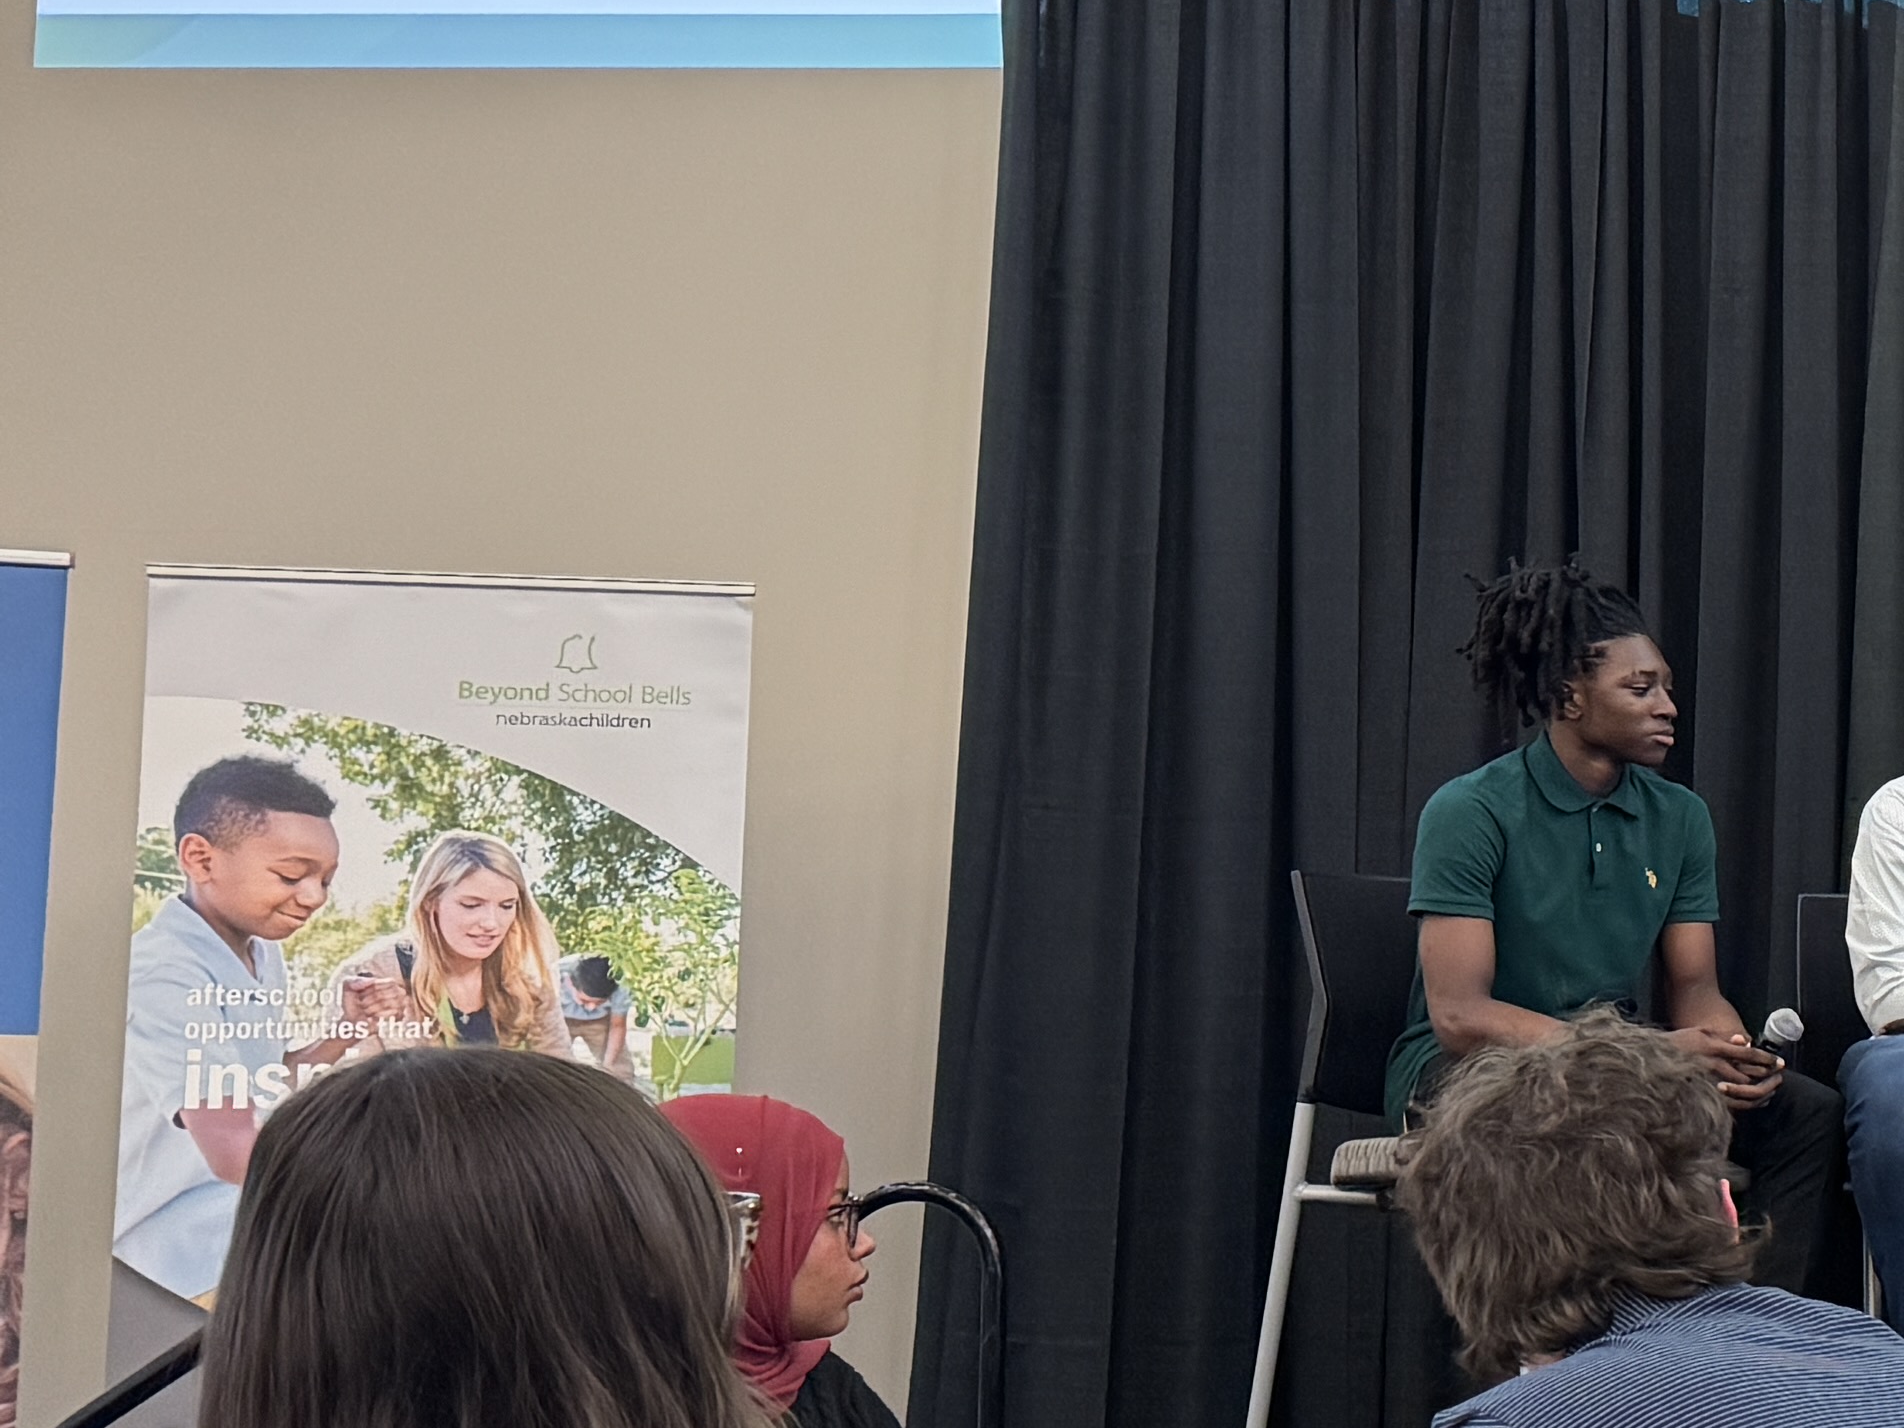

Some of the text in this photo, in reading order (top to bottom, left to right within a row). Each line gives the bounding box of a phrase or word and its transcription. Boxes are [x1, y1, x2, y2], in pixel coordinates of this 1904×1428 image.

[458, 680, 692, 705] Beyond School Bells
[496, 712, 652, 728] nebraskachildren
[186, 982, 342, 1007] afterschool
[184, 1016, 434, 1044] opportunities that
